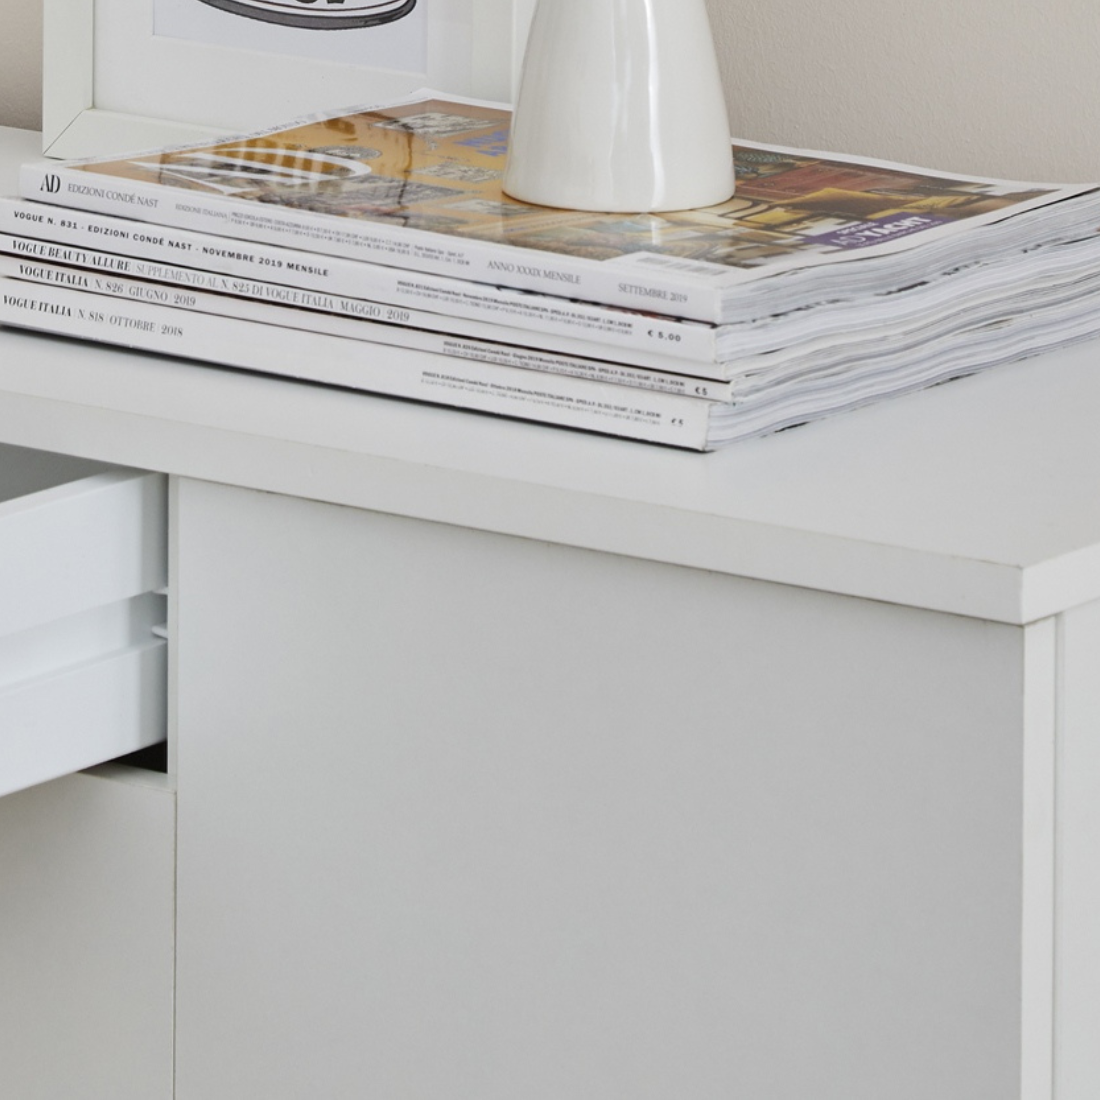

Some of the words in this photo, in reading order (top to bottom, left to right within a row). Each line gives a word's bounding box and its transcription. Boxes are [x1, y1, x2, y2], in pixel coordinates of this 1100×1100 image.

[39, 173, 61, 194] AD
[67, 183, 105, 200] EDIZIONI
[105, 190, 136, 205] CONDÉ
[136, 196, 159, 209] NAST
[14, 211, 44, 223] VOGUE
[47, 217, 57, 226] N.
[60, 220, 78, 229] 831
[87, 224, 129, 239] EDIZIONI
[132, 233, 164, 246] CONDÉ
[167, 240, 192, 251] NAST
[201, 247, 254, 263] NOVEMBRE
[258, 257, 283, 268] 2019
[286, 262, 329, 277] MENSILE
[12, 240, 46, 255] VOGUE
[48, 247, 87, 263] BEAUTY
[91, 255, 131, 271] ALLURE
[136, 263, 205, 284] SUPPLEMENTO
[232, 282, 250, 293] 825
[251, 285, 264, 297] DI
[264, 287, 300, 303] VOGUE
[300, 293, 334, 310] ITALIA
[339, 300, 382, 317] MAGGIO
[386, 309, 410, 322] 2019
[19, 264, 54, 280] VOGUE
[55, 271, 89, 288] ITALIA
[106, 282, 124, 294] 826
[128, 285, 169, 302] GIUGNO
[173, 294, 197, 306] 2019
[487, 260, 515, 273] ANNO
[542, 269, 581, 285] MENSILE
[618, 283, 668, 300] SETTEMBRE
[670, 292, 688, 303] 2019
[3, 294, 38, 310] VOGUE
[38, 301, 71, 317] ITALIA
[109, 314, 155, 333] OTTOBRE
[160, 323, 184, 337] 2018
